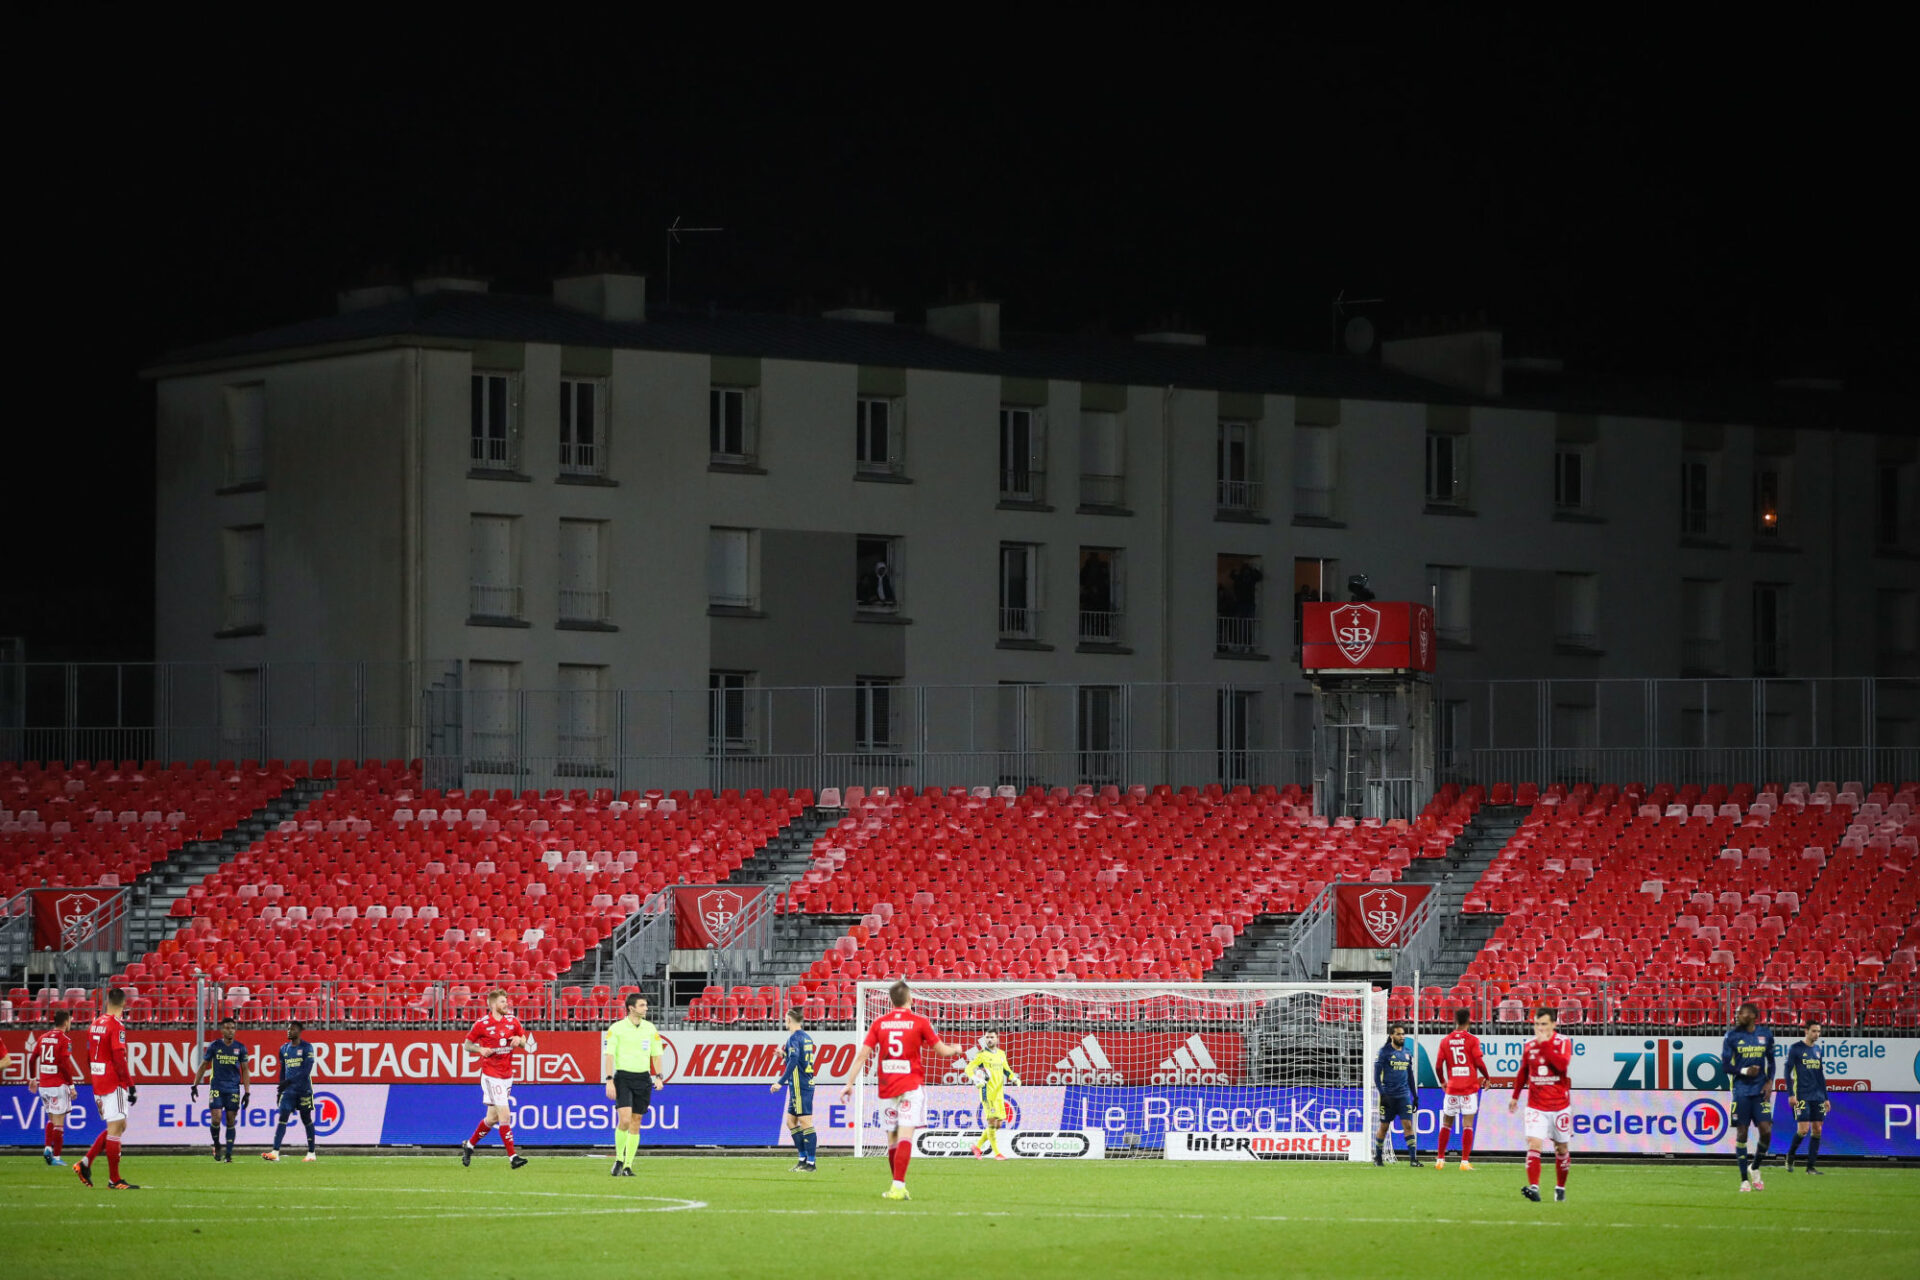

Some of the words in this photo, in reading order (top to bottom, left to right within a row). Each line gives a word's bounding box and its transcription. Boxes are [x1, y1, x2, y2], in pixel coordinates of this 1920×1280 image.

[1339, 627, 1372, 643] SB
[1368, 910, 1398, 926] SB
[92, 1035, 101, 1060] 7
[888, 1031, 904, 1057] 5
[41, 1044, 56, 1063] 14
[308, 1042, 482, 1078] RETAGNE
[1450, 1046, 1467, 1064] 15
[1046, 1067, 1124, 1085] adidas
[1151, 1068, 1230, 1086] adidas
[1021, 1137, 1080, 1150] trecobois
